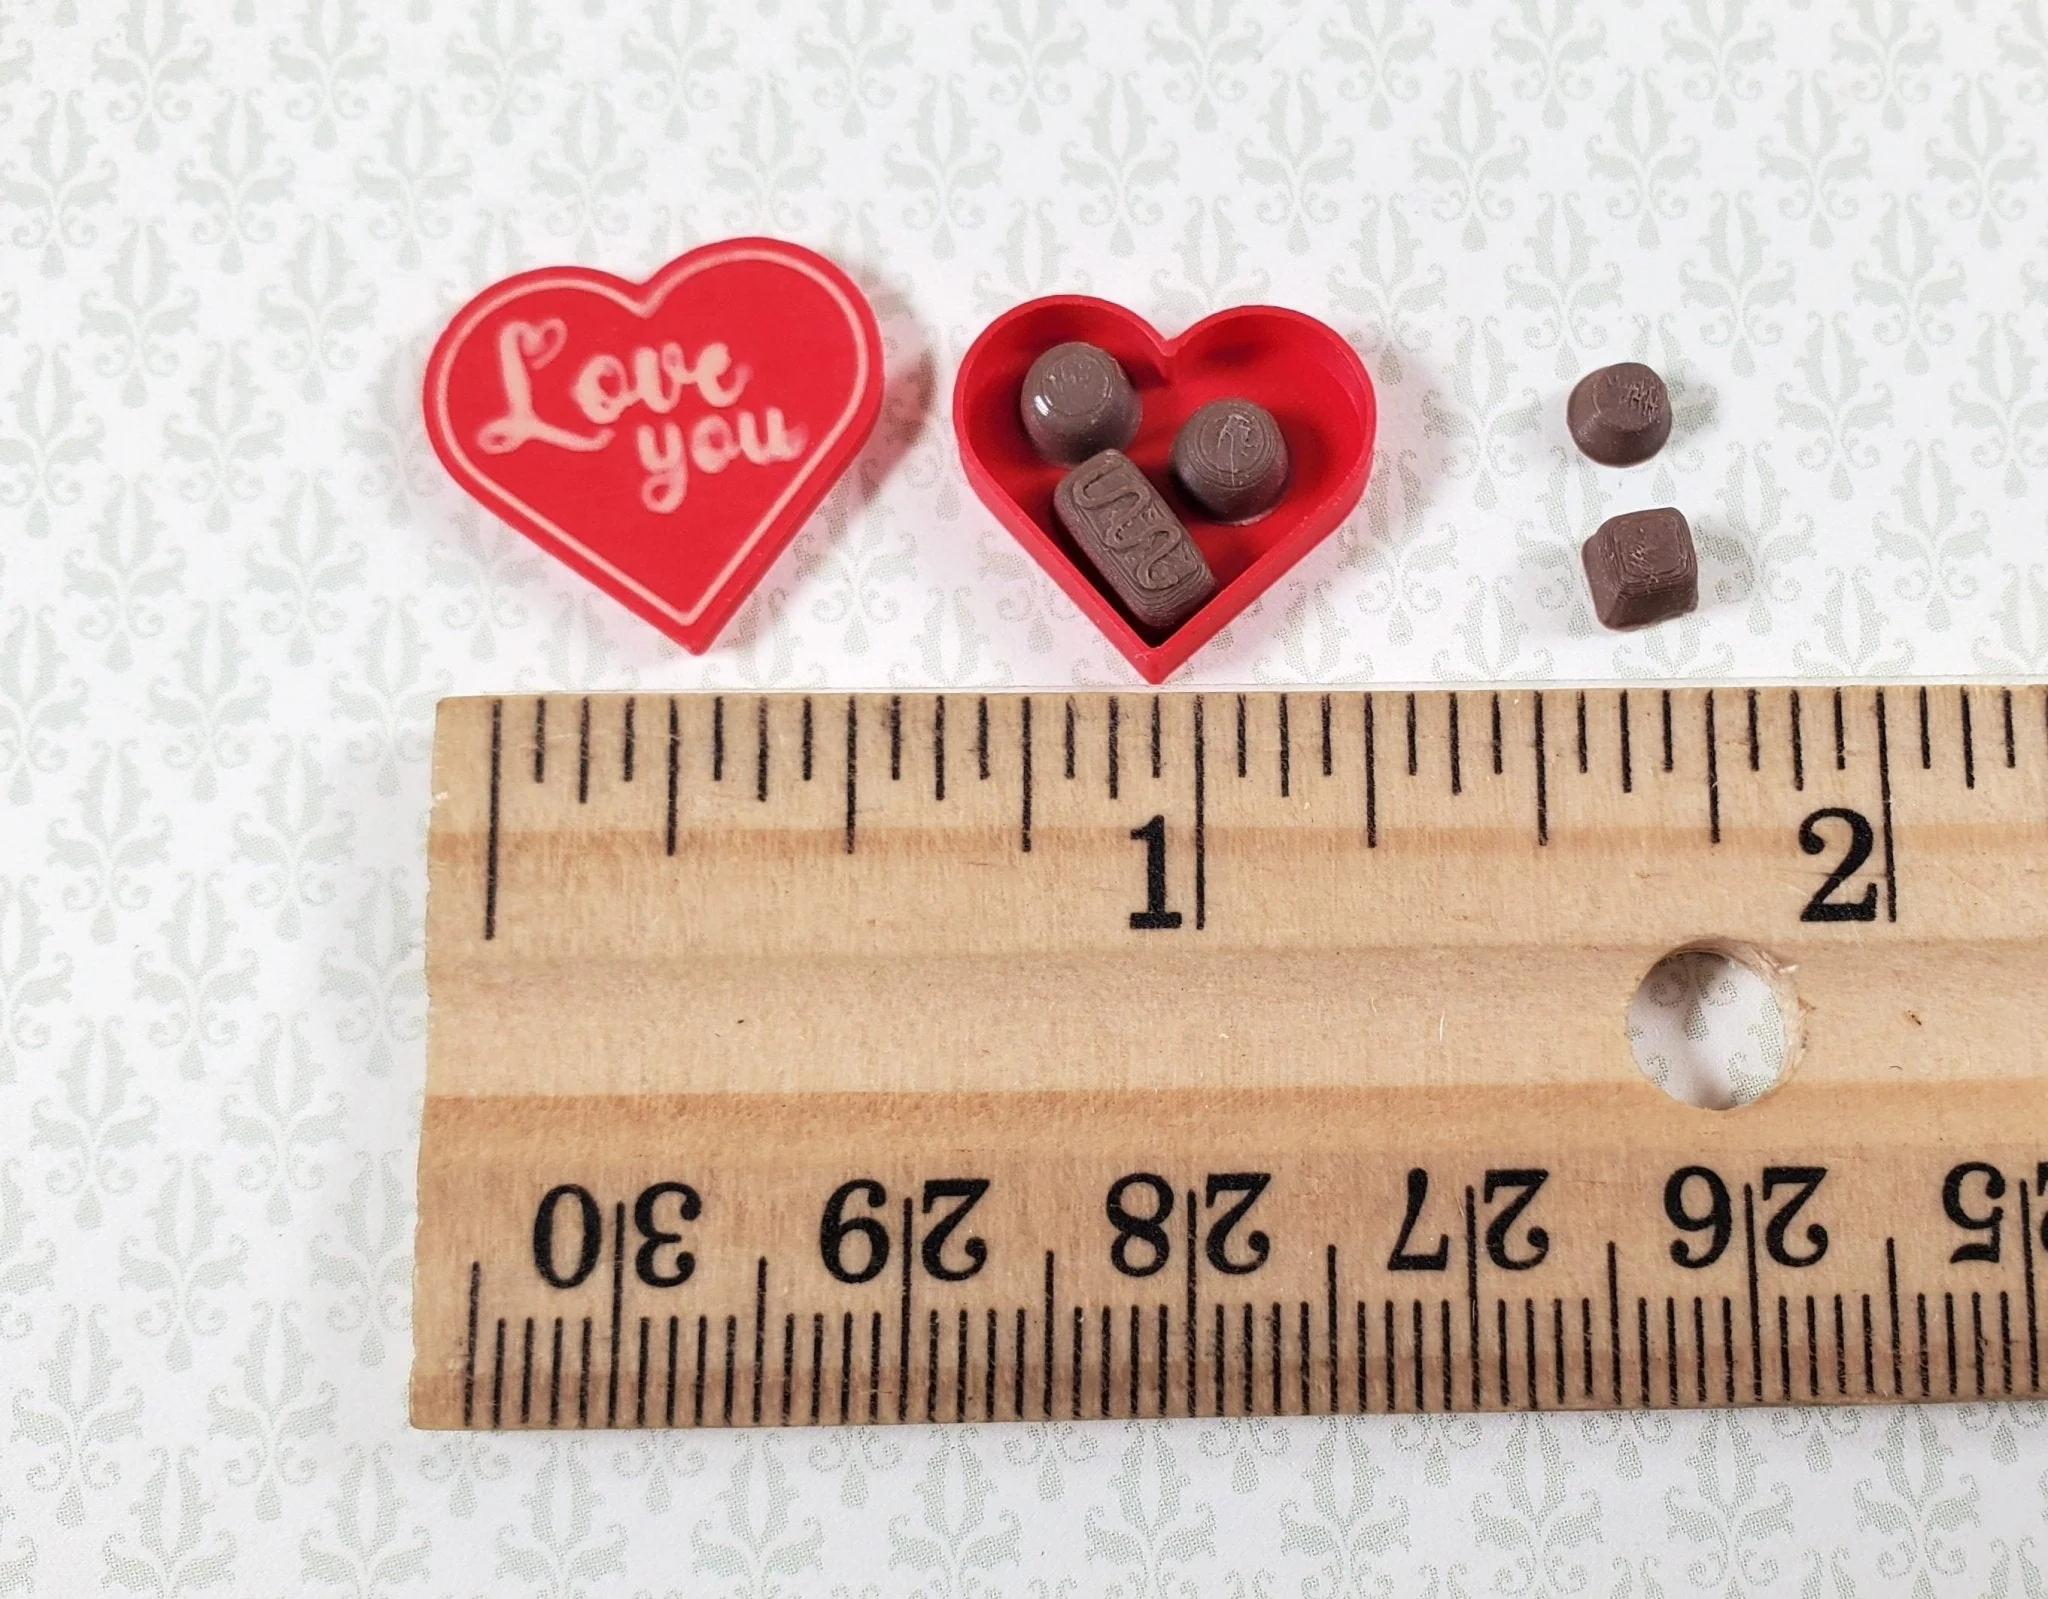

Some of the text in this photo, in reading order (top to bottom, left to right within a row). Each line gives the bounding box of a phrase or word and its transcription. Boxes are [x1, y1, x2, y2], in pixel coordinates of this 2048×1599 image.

[476, 317, 751, 454] Love
[635, 406, 808, 513] you
[1129, 807, 1878, 930] 1 2
[532, 1161, 2048, 1290] 5 26 27 28 29 30
